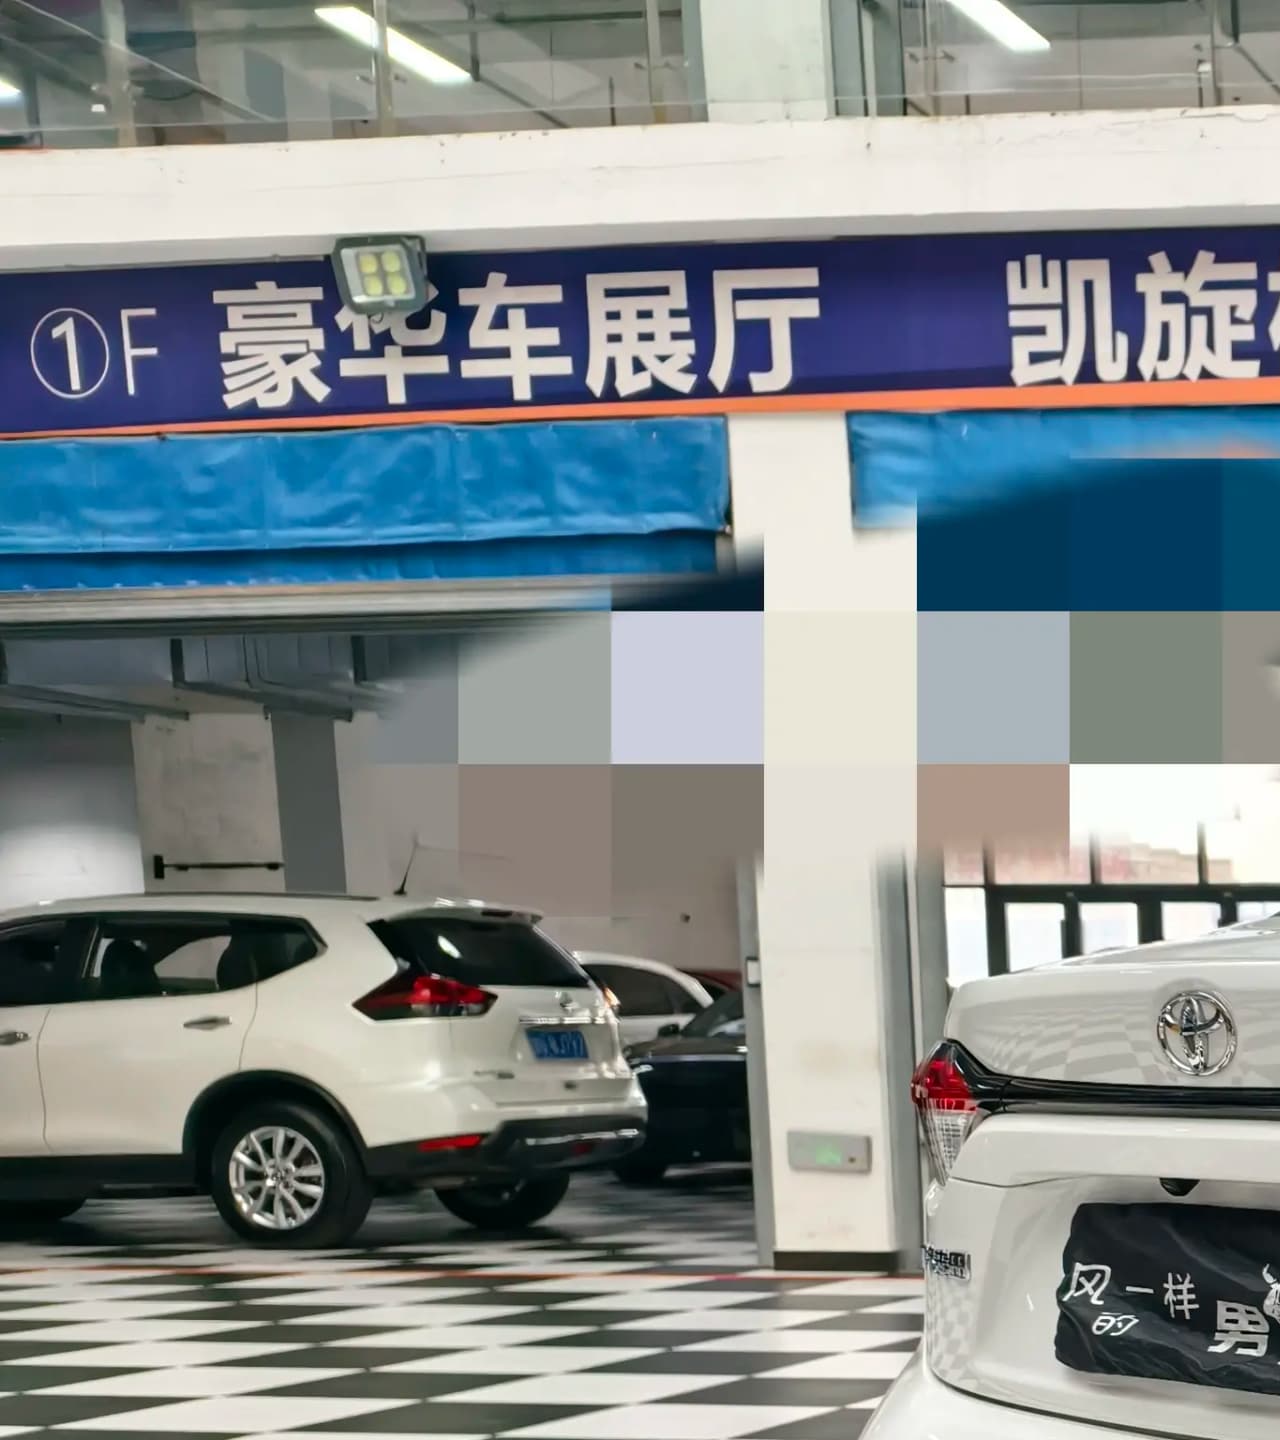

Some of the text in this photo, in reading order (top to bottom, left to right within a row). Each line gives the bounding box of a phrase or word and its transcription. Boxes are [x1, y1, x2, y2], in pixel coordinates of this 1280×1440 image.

[212, 267, 822, 410] 豪华车展厅
